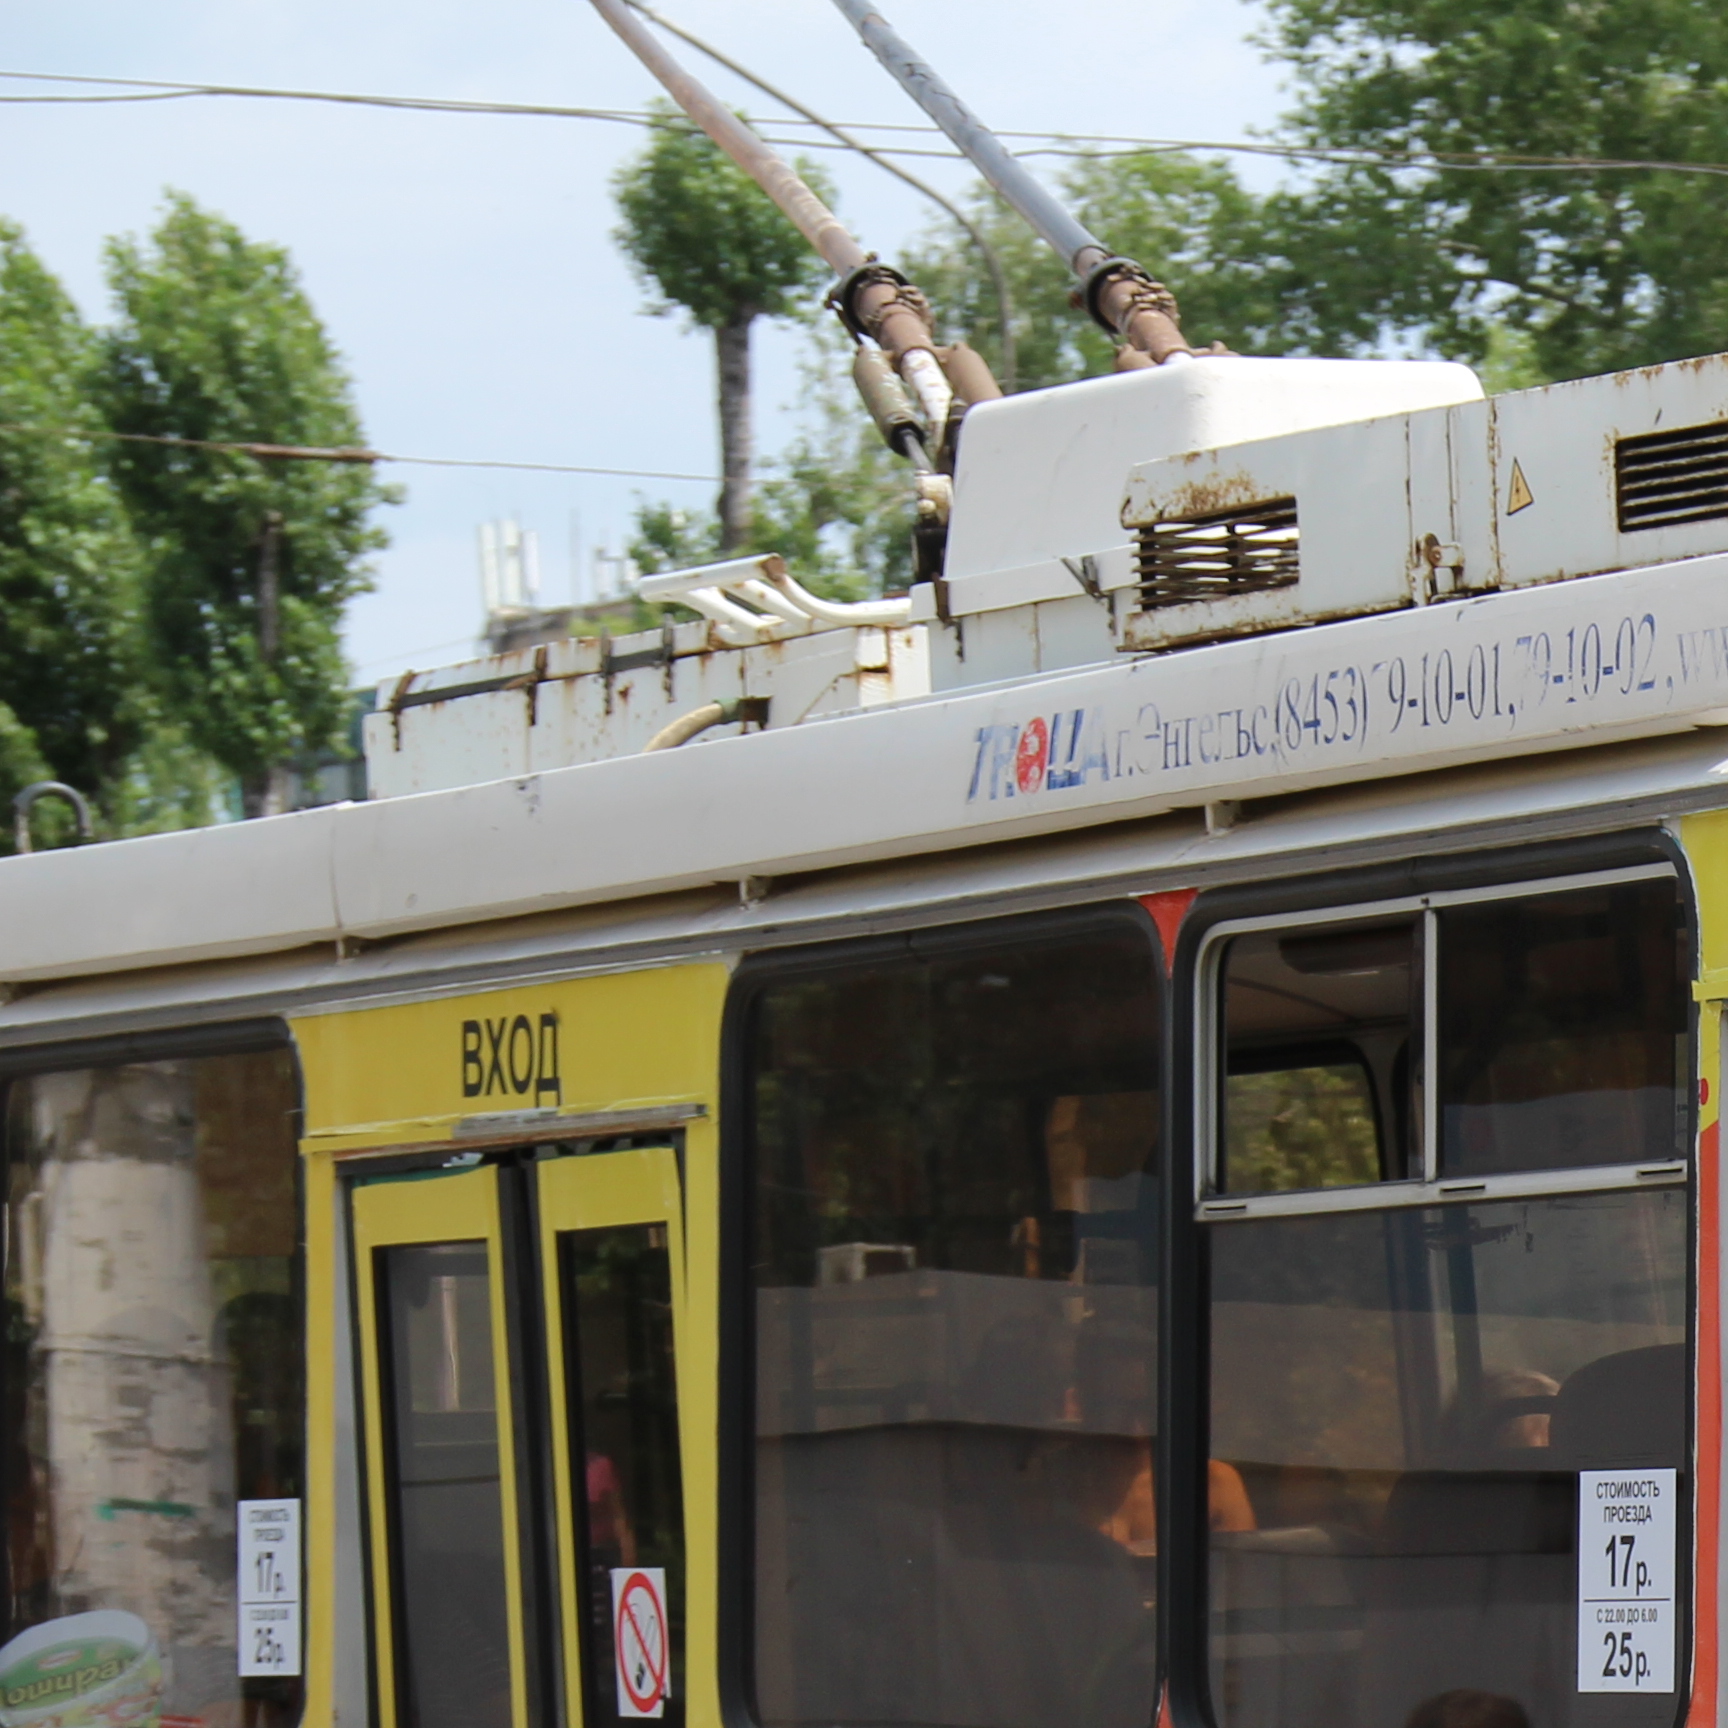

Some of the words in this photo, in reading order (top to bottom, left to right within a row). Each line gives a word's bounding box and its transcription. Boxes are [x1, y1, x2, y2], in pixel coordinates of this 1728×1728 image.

[461, 1011, 561, 1109] ВХОД
[1596, 1480, 1660, 1499] СТОИМОСТЬ
[1604, 1505, 1652, 1524] ПРОЕЗДА
